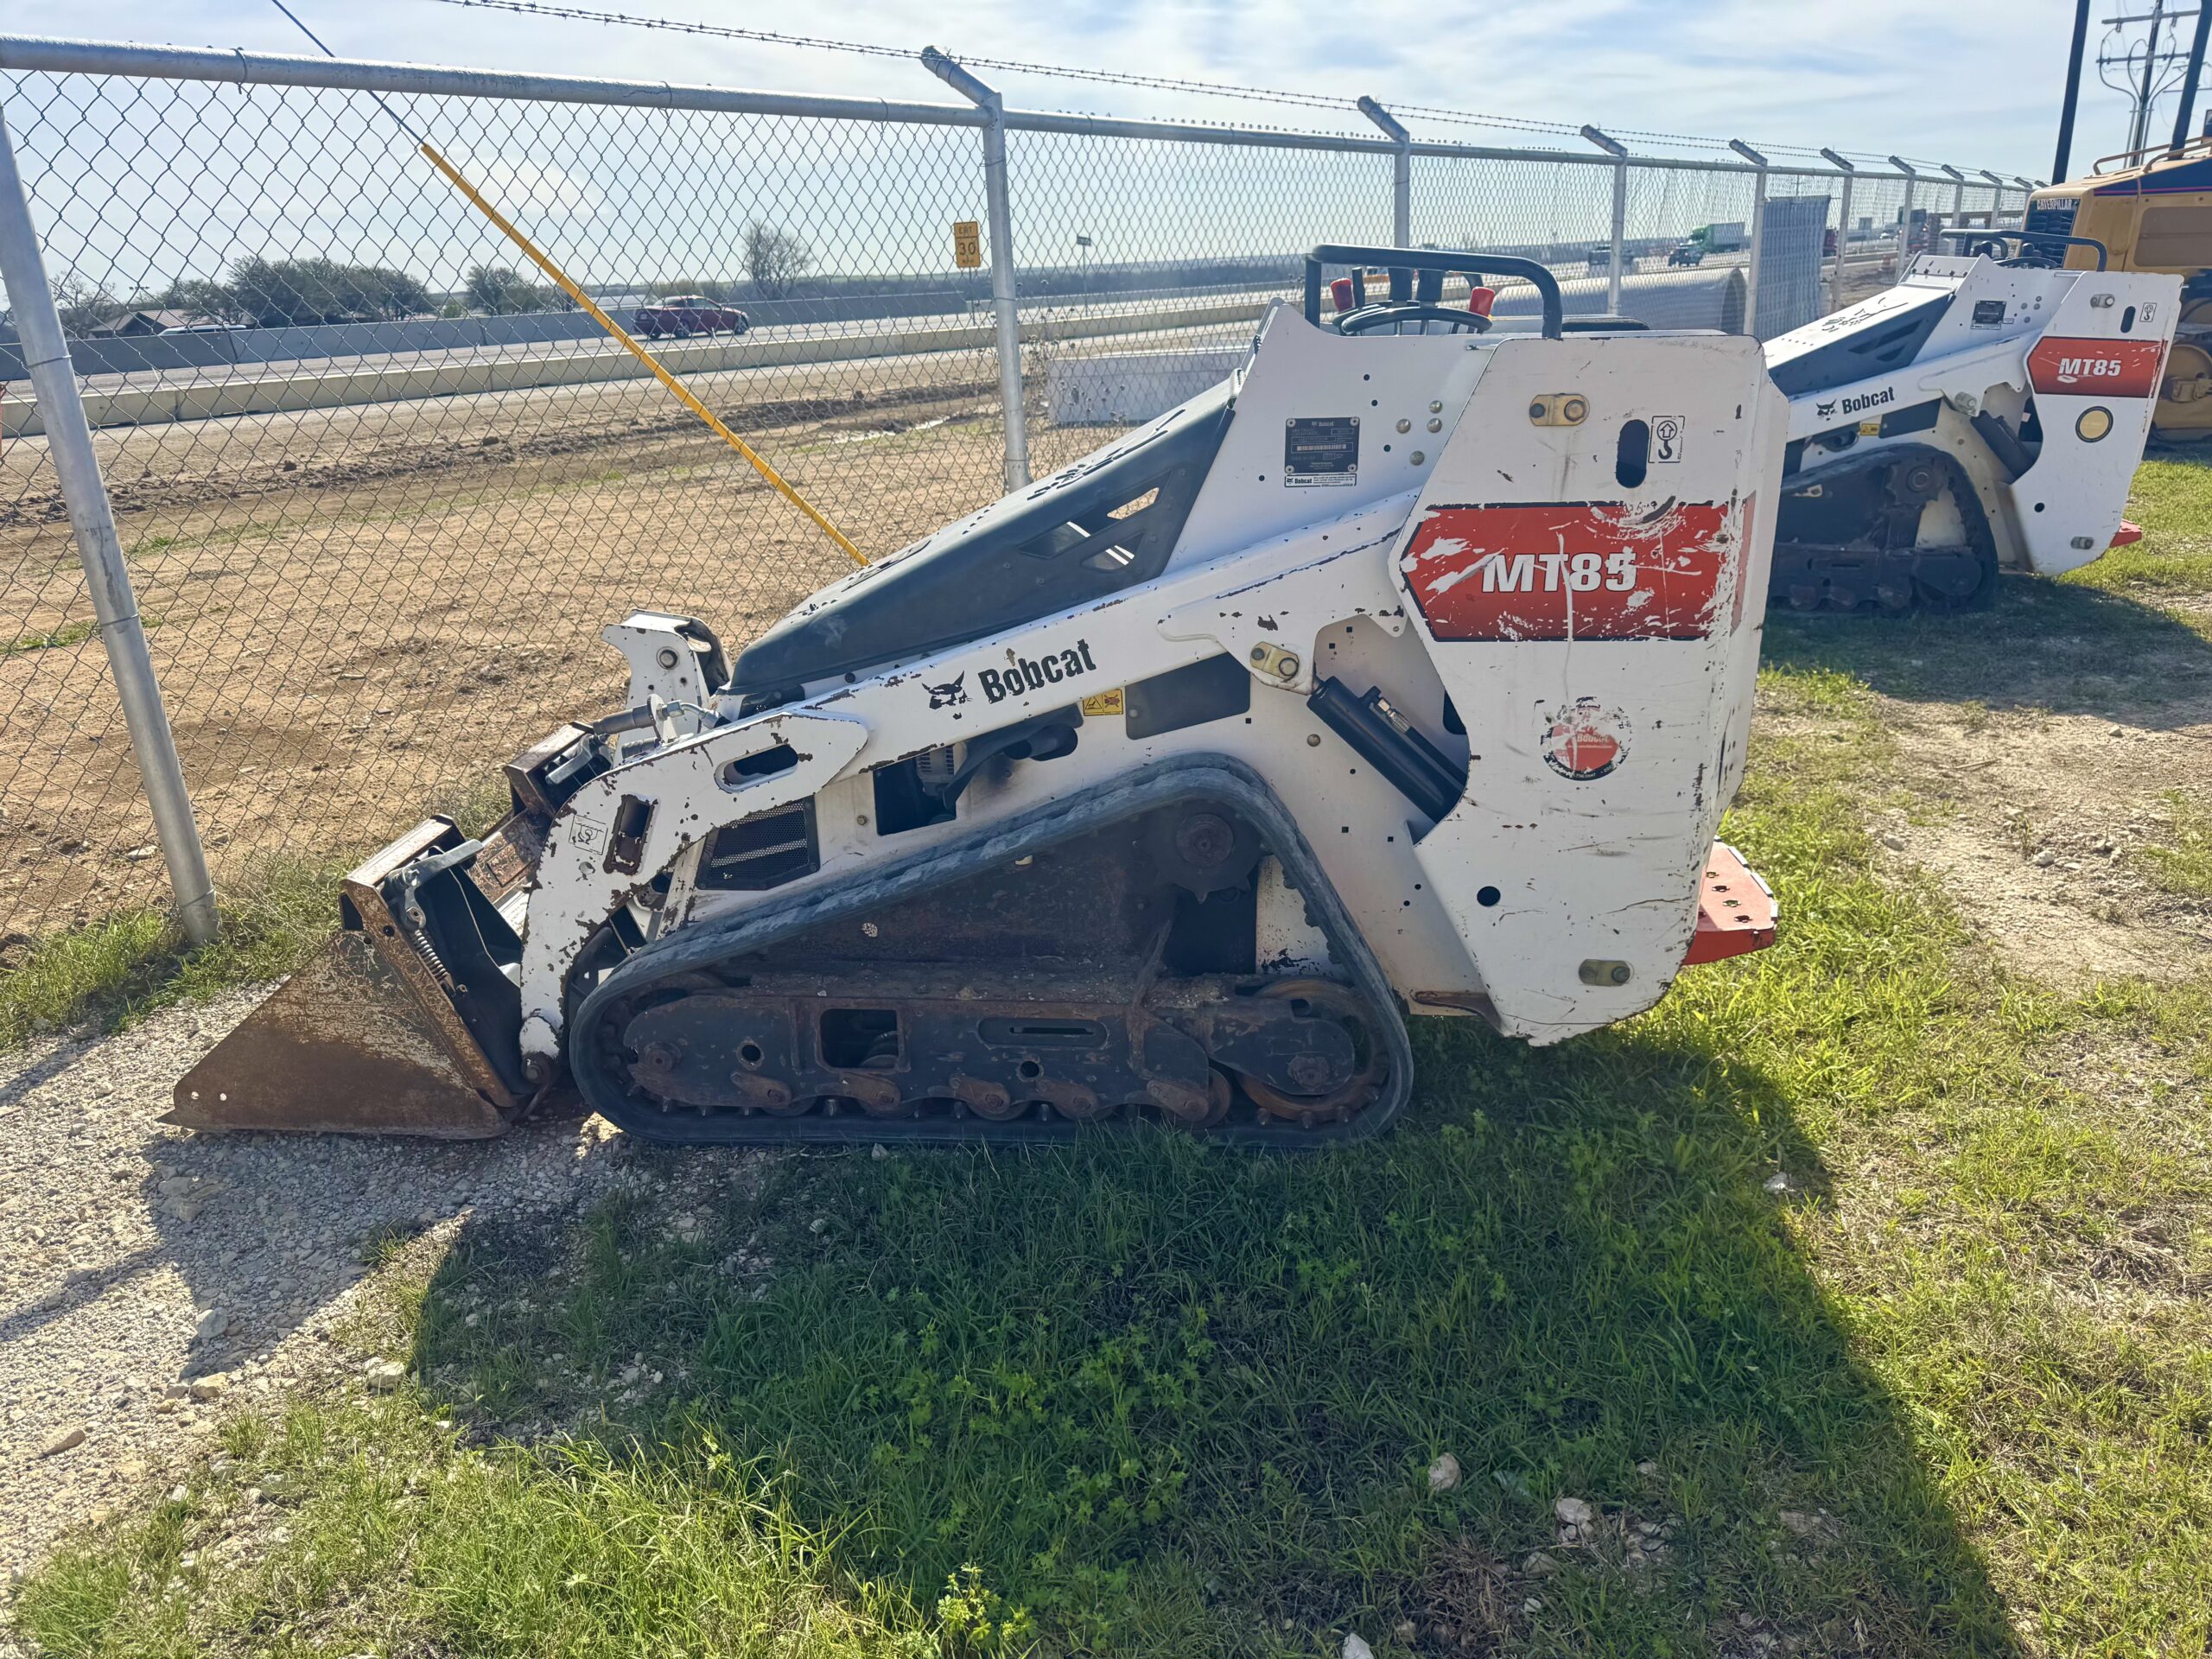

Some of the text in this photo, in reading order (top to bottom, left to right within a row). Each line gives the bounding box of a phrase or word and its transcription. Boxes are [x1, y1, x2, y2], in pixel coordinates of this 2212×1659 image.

[2037, 199, 2072, 210] CATERPILLAR
[959, 242, 976, 255] 30
[2058, 358, 2121, 376] MT85
[1842, 386, 1894, 414] Bobcat
[1482, 551, 1637, 593] MT85
[978, 639, 1096, 704] Bobcat
